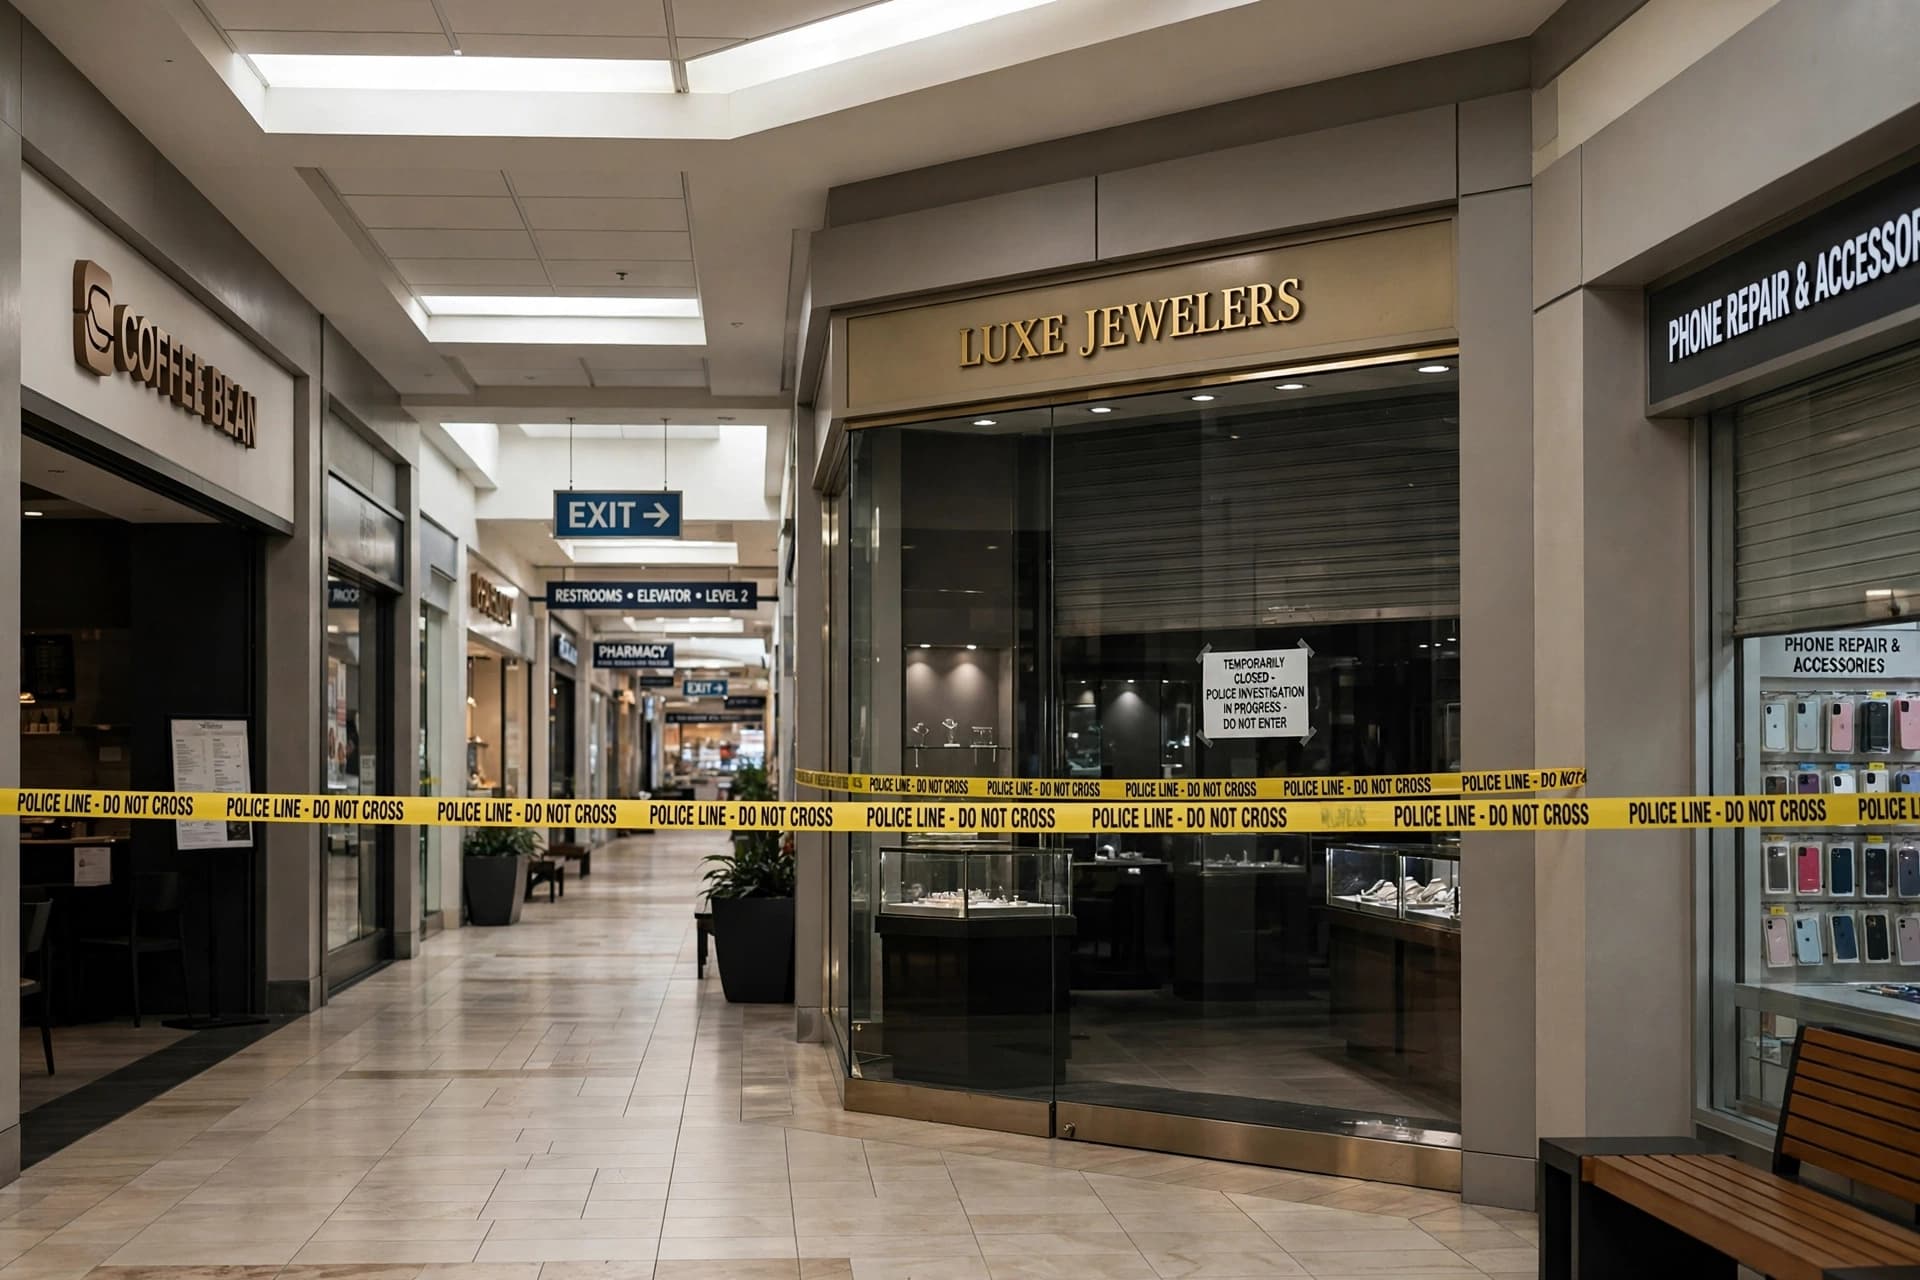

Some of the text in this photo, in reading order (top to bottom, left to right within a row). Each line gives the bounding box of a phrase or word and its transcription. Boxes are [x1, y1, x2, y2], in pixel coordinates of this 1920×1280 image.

[1669, 298, 1722, 362] PHONE
[1727, 270, 1790, 339] REPAIR
[1795, 261, 1810, 309] &
[959, 278, 1302, 367] LUXE JEWELERS
[114, 304, 257, 448] COFFEE BEAN
[569, 502, 636, 528] EXIT
[555, 589, 623, 602] RESTROOMS
[637, 589, 691, 602] ELEVATOR
[706, 589, 739, 602] LEVEL
[741, 589, 749, 602] 2
[599, 645, 667, 658] PHARMACY
[1785, 637, 1901, 653] PHONE REPAIR &
[1224, 657, 1285, 669] TEMPORARILY
[1793, 657, 1885, 673] ACCESSORIES
[687, 682, 712, 694] EXIT
[1234, 672, 1269, 684] CLOSED
[1206, 686, 1305, 700] POLICE INVESTIGATION
[1224, 703, 1232, 714] IN
[1235, 701, 1281, 714] PROGRESS
[1224, 716, 1287, 730] DO NOT ENTER
[870, 778, 893, 792] POLICE
[895, 779, 911, 792] LINE
[917, 779, 926, 792] DO
[929, 779, 942, 792] NOT
[945, 780, 968, 794] CROSS
[987, 780, 1014, 795] POLICE
[1016, 780, 1033, 795] LINE
[1039, 780, 1051, 795] DO
[1054, 781, 1070, 796] NOT
[1072, 782, 1100, 796] CROSS
[1126, 782, 1156, 797] POLICE
[1159, 782, 1179, 797] LINE
[1188, 782, 1200, 797] DO
[1203, 782, 1221, 797] NOT
[1225, 781, 1256, 797] CROSS
[1284, 780, 1318, 796] POLICE
[1321, 779, 1344, 795] LINE
[1354, 779, 1368, 794] DO
[1371, 778, 1392, 794] NOT
[1395, 777, 1431, 793] CROSS
[1462, 775, 1501, 792] POLICE
[1505, 774, 1530, 789] LINE
[1541, 772, 1556, 787] DO
[1560, 771, 1582, 786] NOT
[17, 793, 60, 812] POLICE
[64, 794, 91, 813] LINE
[103, 795, 120, 814] DO
[124, 796, 149, 814] NOT
[152, 796, 193, 815] CROSS
[227, 798, 269, 817] POLICE
[274, 799, 301, 818] LINE
[313, 800, 330, 819] DO
[334, 800, 359, 819] NOT
[362, 800, 403, 820] CROSS
[438, 802, 481, 822] POLICE
[486, 803, 512, 822] LINE
[525, 803, 542, 823] DO
[547, 804, 571, 823] NOT
[575, 804, 617, 824] CROSS
[1630, 802, 1677, 824] POLICE
[1682, 802, 1711, 823] LINE
[1725, 801, 1744, 823] DO
[1749, 800, 1775, 822] NOT
[1780, 799, 1826, 821] CROSS
[1859, 798, 1907, 820] POLICE
[650, 805, 694, 825] POLICE
[698, 806, 726, 825] LINE
[739, 806, 756, 826] DO
[761, 807, 786, 826] NOT
[791, 807, 833, 827] CROSS
[867, 807, 912, 827] POLICE
[916, 808, 946, 828] LINE
[959, 808, 976, 828] DO
[981, 808, 1007, 828] NOT
[1012, 808, 1055, 828] CROSS
[1093, 808, 1139, 828] POLICE
[1144, 808, 1173, 828] LINE
[1187, 808, 1205, 828] DO
[1211, 807, 1237, 828] NOT
[1242, 807, 1287, 828] CROSS
[1395, 805, 1441, 827] POLICE
[1446, 805, 1475, 826] LINE
[1489, 804, 1507, 826] DO
[1513, 804, 1539, 825] NOT
[1544, 803, 1589, 825] CROSS
